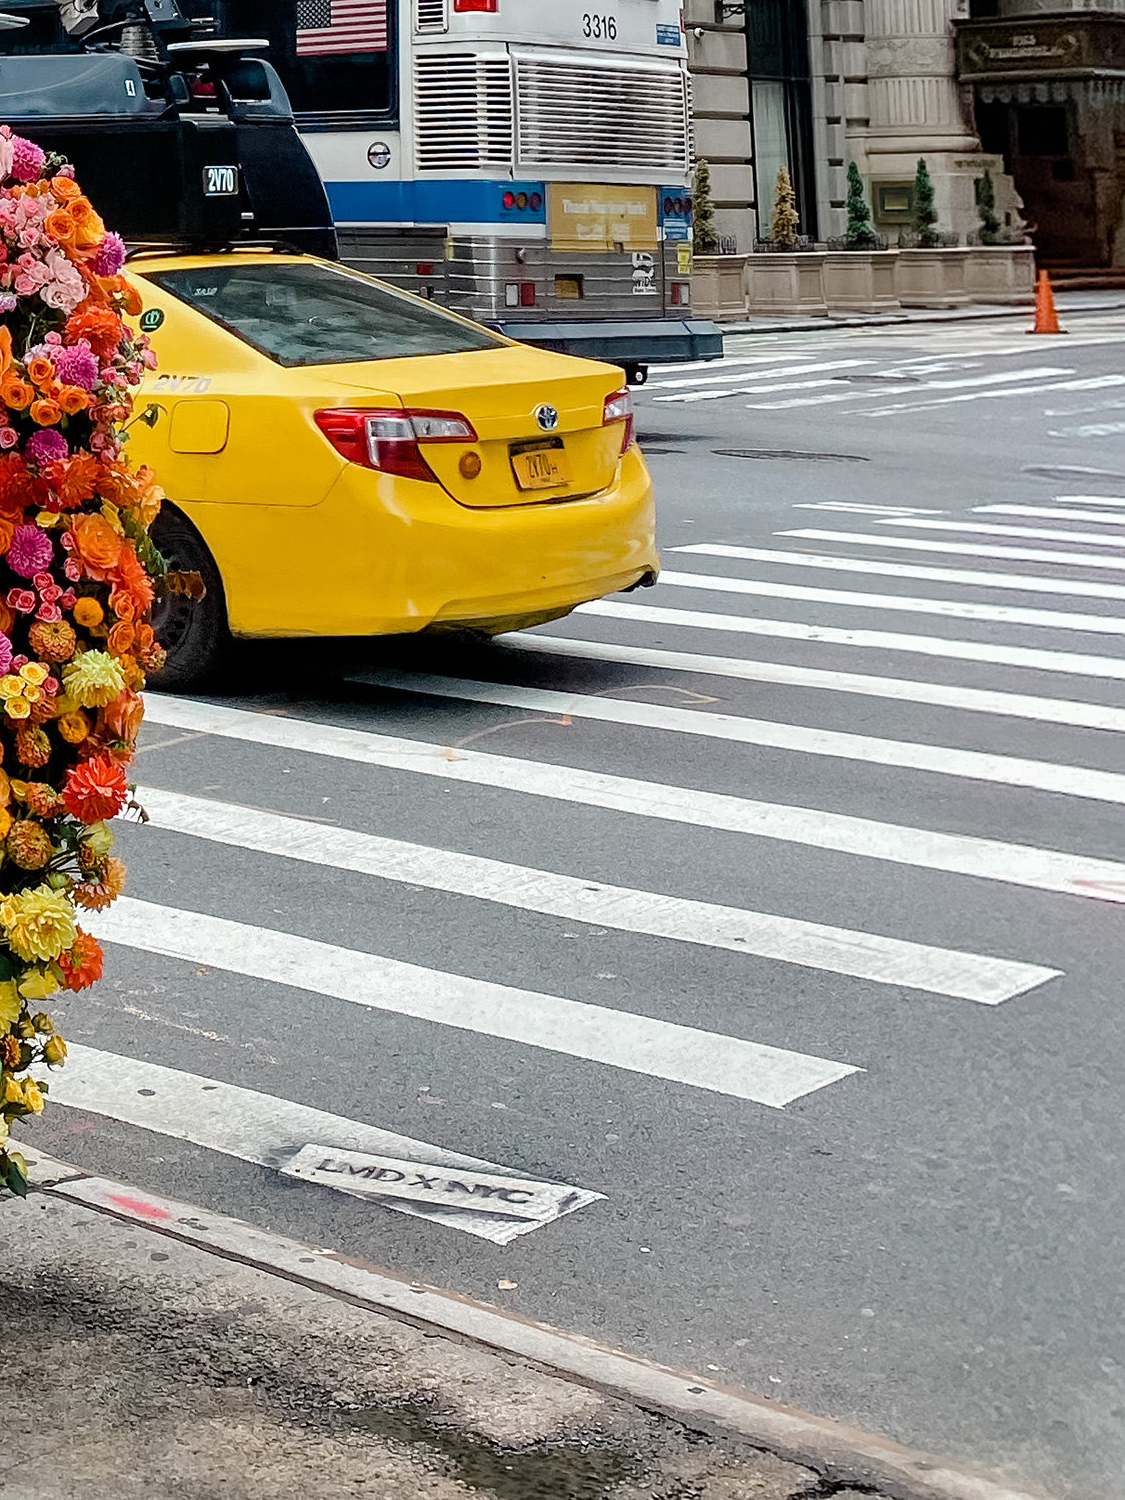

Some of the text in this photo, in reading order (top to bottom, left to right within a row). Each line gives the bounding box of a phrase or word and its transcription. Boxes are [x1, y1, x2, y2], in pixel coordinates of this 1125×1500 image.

[582, 13, 617, 40] 3316
[208, 168, 234, 192] 2V70
[153, 374, 212, 393] 2V70
[315, 1158, 406, 1182] LMD
